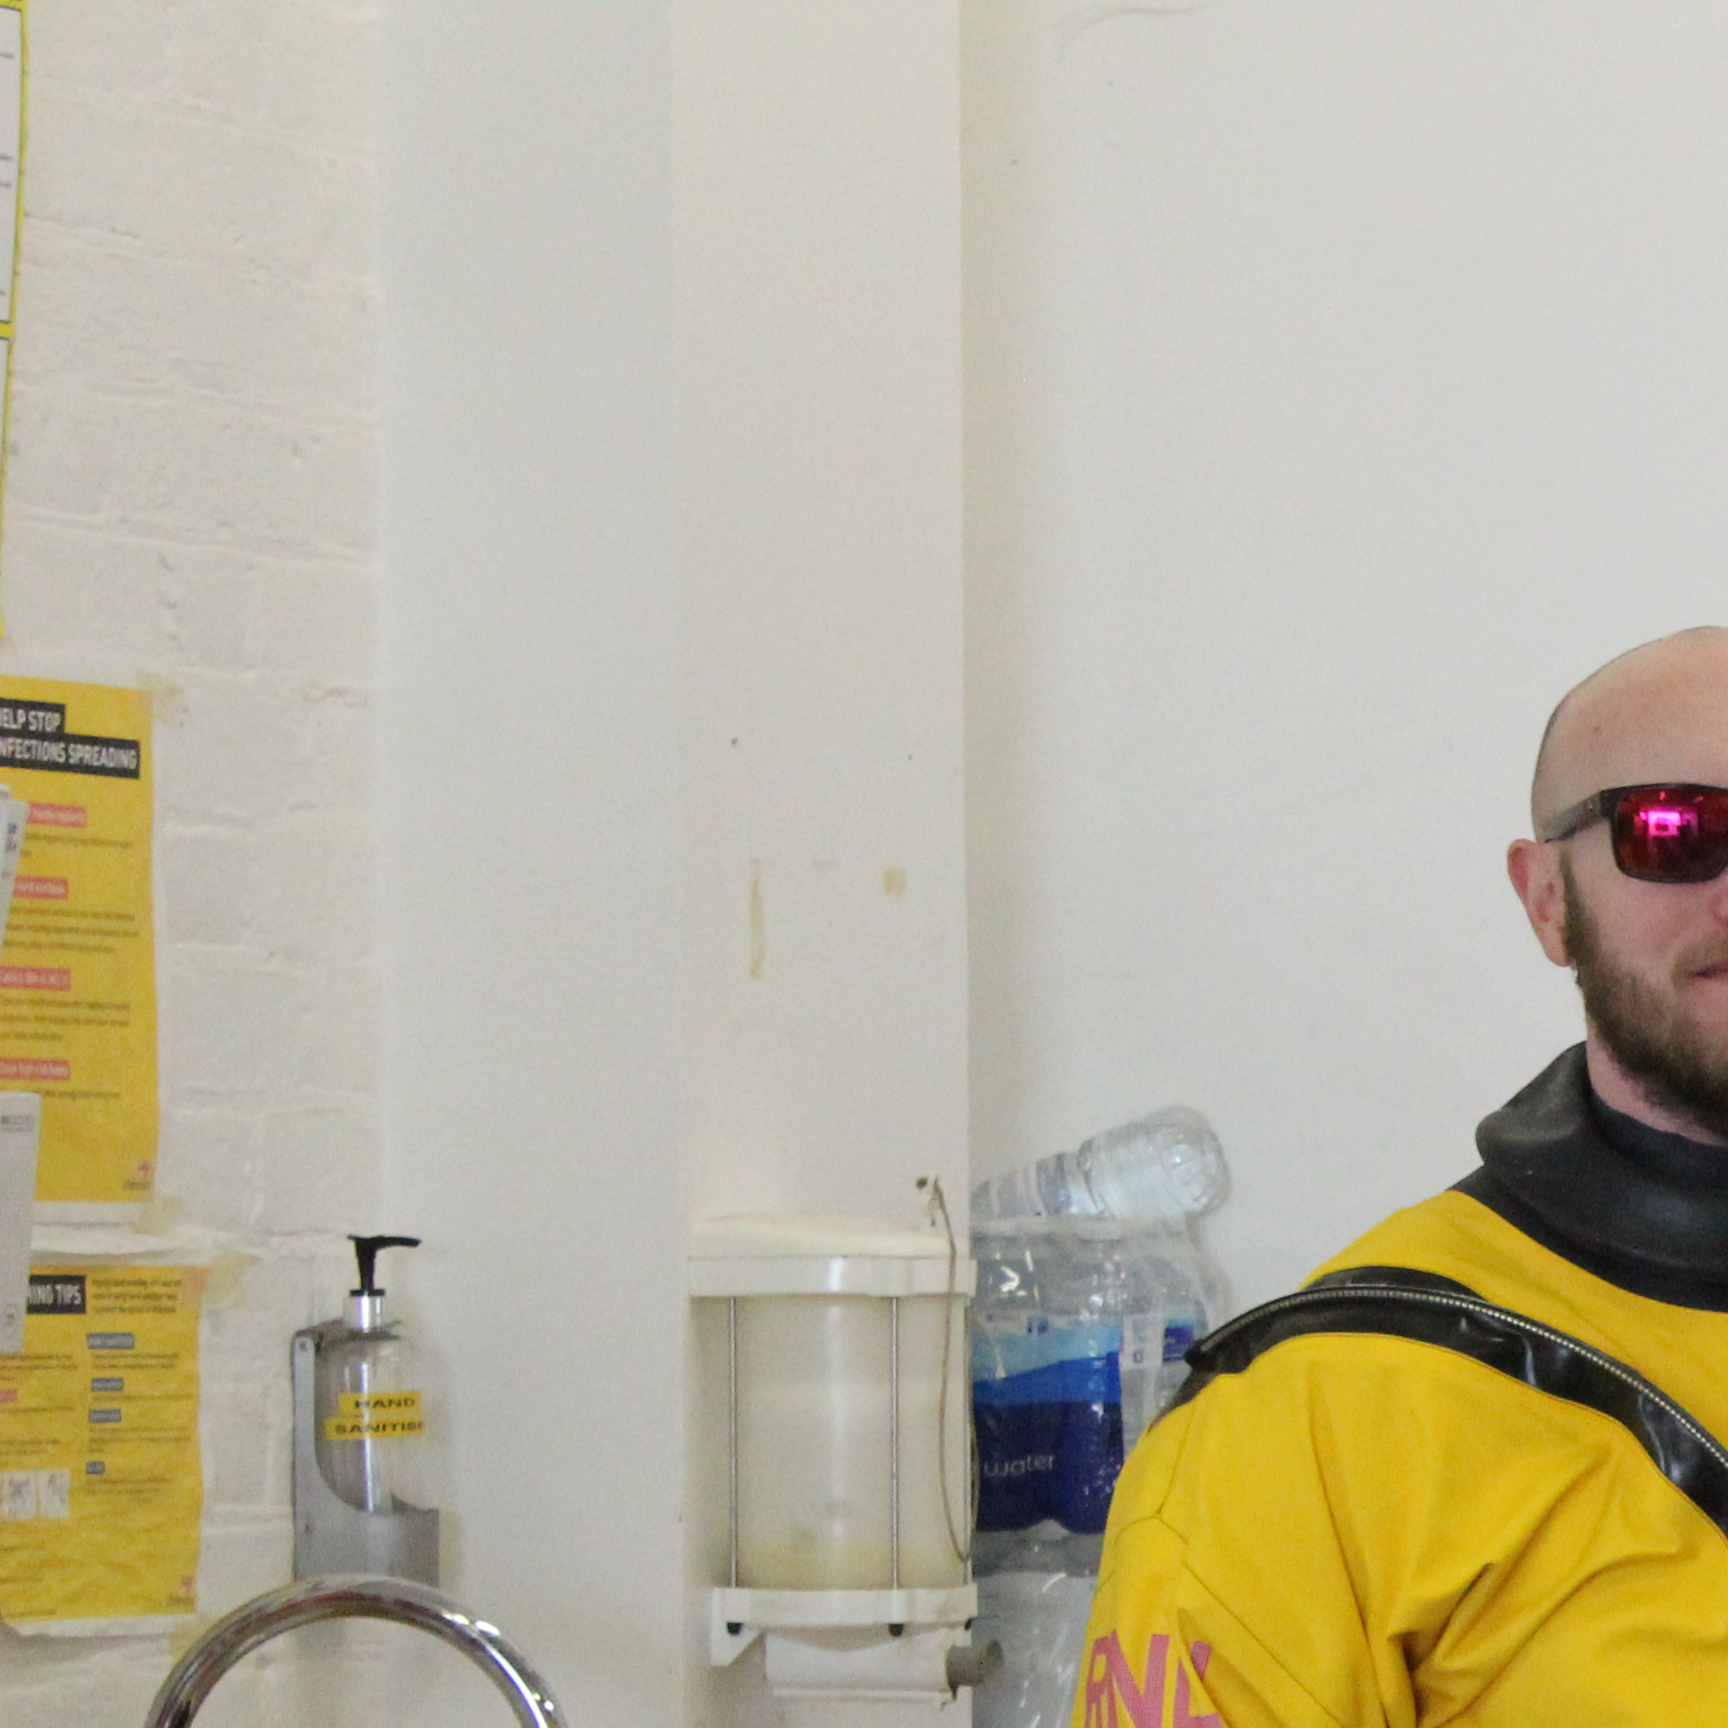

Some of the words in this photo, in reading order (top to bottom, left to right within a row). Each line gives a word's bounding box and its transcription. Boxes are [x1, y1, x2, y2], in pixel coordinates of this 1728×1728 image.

[28, 709, 61, 733] STOP
[0, 735, 66, 763] NFECTIONS
[68, 743, 138, 770] SPREADING
[55, 1283, 81, 1306] TIPS
[355, 1398, 416, 1409] HAND
[984, 1454, 1055, 1478] water
